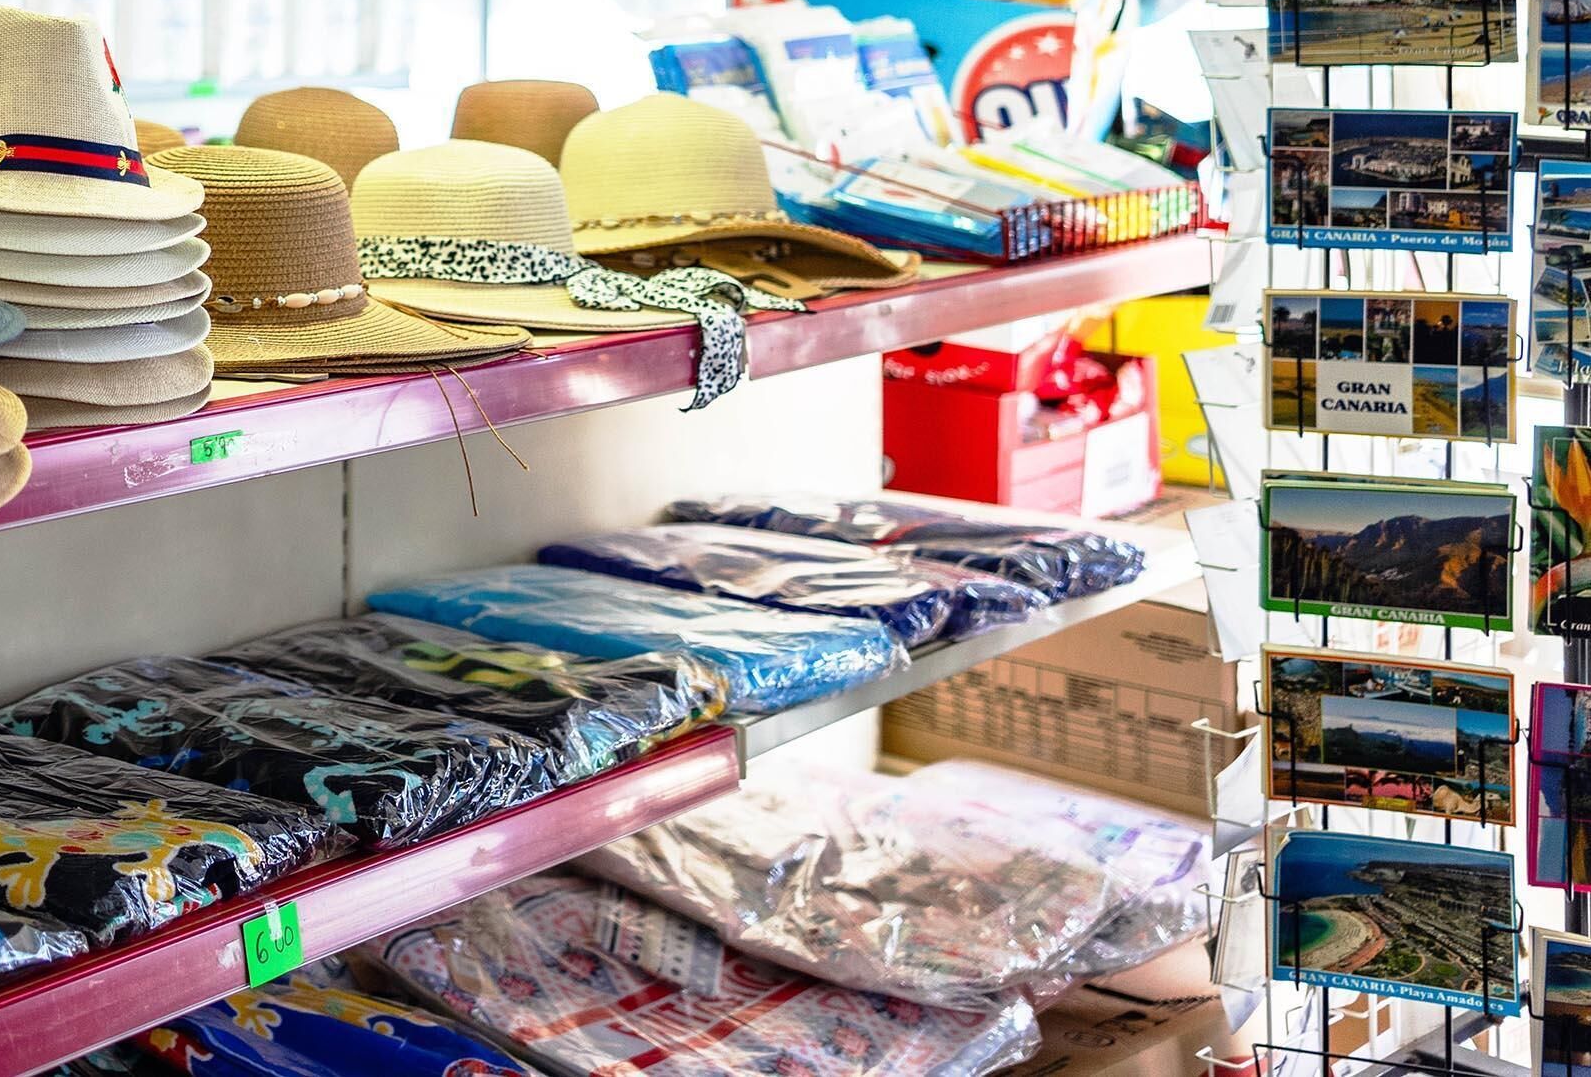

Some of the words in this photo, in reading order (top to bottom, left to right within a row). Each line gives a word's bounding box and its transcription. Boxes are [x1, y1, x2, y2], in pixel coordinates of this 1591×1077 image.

[1556, 110, 1591, 124] GRA
[1271, 230, 1309, 240] GRAN
[1314, 232, 1377, 242] CANARIA
[1391, 234, 1436, 244] Puerto
[1441, 236, 1457, 245] de
[1337, 381, 1390, 394] GRAN
[1321, 398, 1407, 414] CANARIA
[1330, 605, 1372, 618] GRAN
[1377, 610, 1445, 623] CANARIA
[1289, 972, 1327, 983] GRAN
[1437, 992, 1504, 1011] Amadoes
